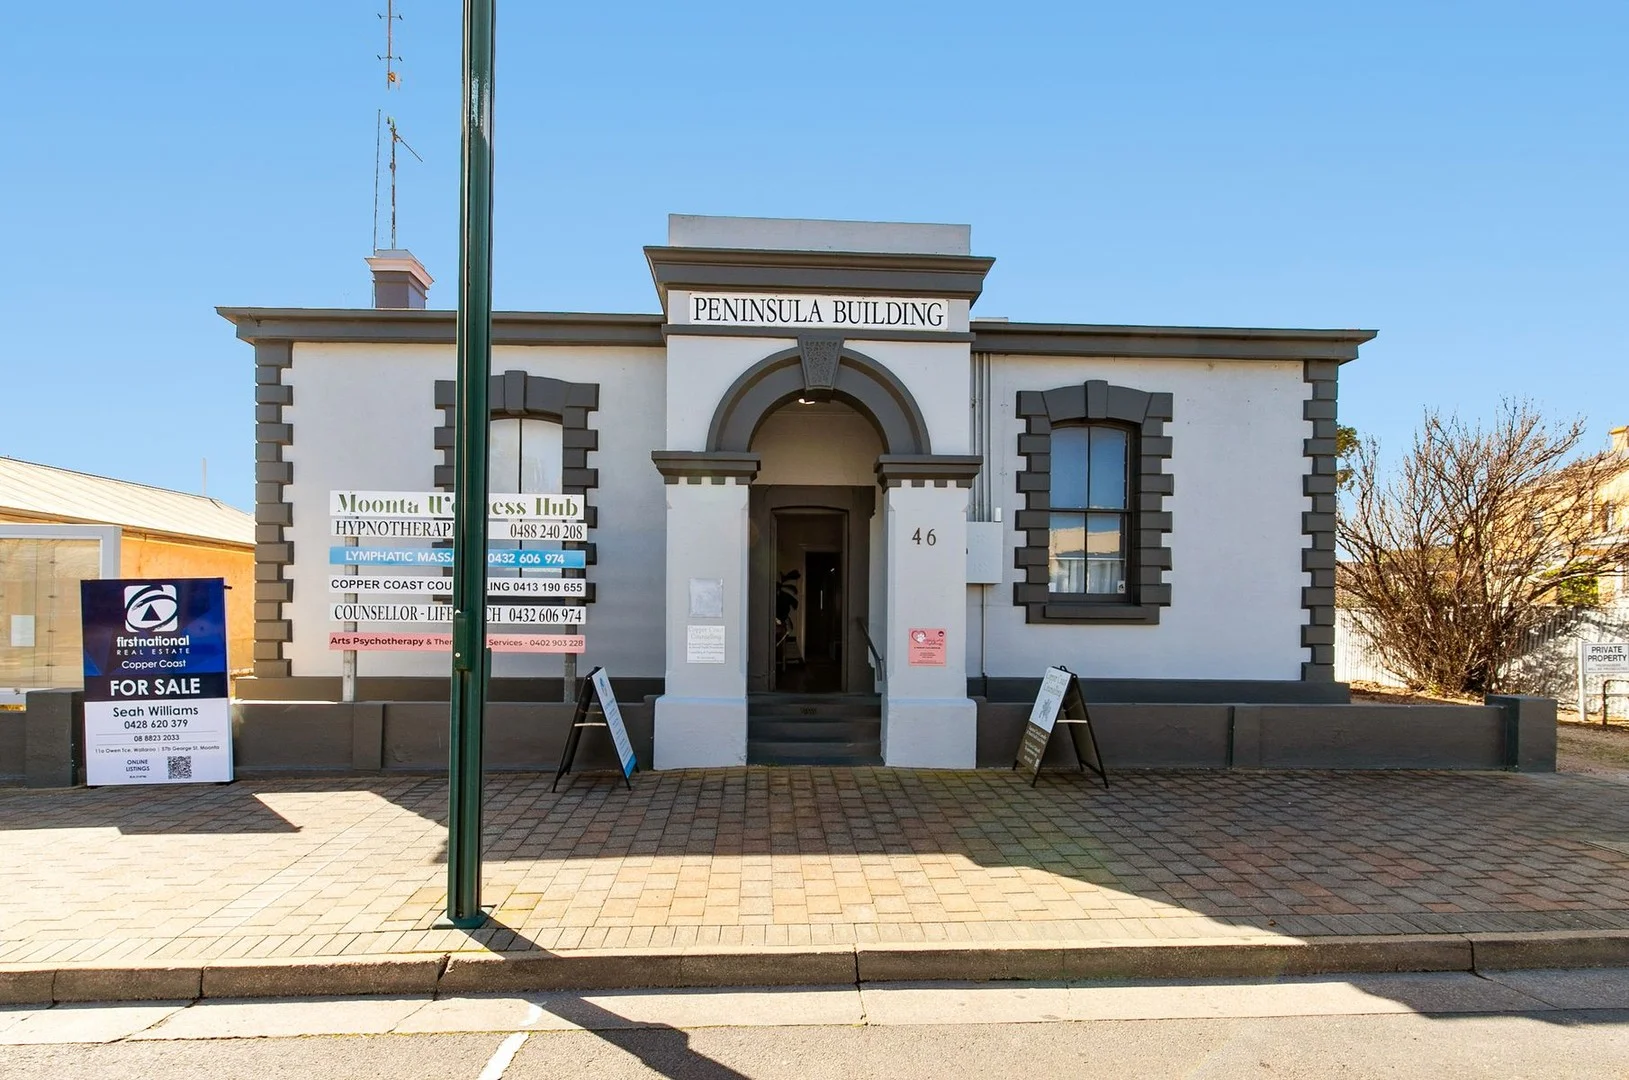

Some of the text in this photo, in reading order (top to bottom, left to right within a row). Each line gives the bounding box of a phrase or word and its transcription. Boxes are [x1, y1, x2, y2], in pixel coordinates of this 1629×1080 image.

[693, 297, 944, 326] PENINSULA BUILDING
[338, 494, 419, 514] Moonta
[536, 498, 578, 516] Hub
[510, 524, 537, 538] 0488
[540, 524, 560, 539] 240
[562, 525, 583, 539] 208
[912, 528, 936, 546] 46
[346, 551, 413, 561] LYMPHATIC
[488, 554, 515, 563] 0432
[520, 554, 540, 563] 606
[544, 554, 565, 564] 974
[331, 580, 380, 589] COPPER
[383, 580, 424, 590] COAST
[513, 582, 538, 591] 0413
[543, 583, 560, 592] 190
[564, 583, 582, 592] 655
[334, 605, 418, 620] COUNSELLOR
[428, 606, 453, 620] LIFE
[509, 608, 536, 622] 0432
[539, 608, 559, 622] 606
[561, 608, 582, 623] 974
[116, 635, 189, 647] firstnational
[353, 637, 424, 646] Psychotherapy
[122, 660, 186, 669] Copper Coast
[110, 678, 200, 696] FOR SALE
[113, 706, 199, 717] Seah Williams
[124, 719, 188, 729] 0428 620 379
